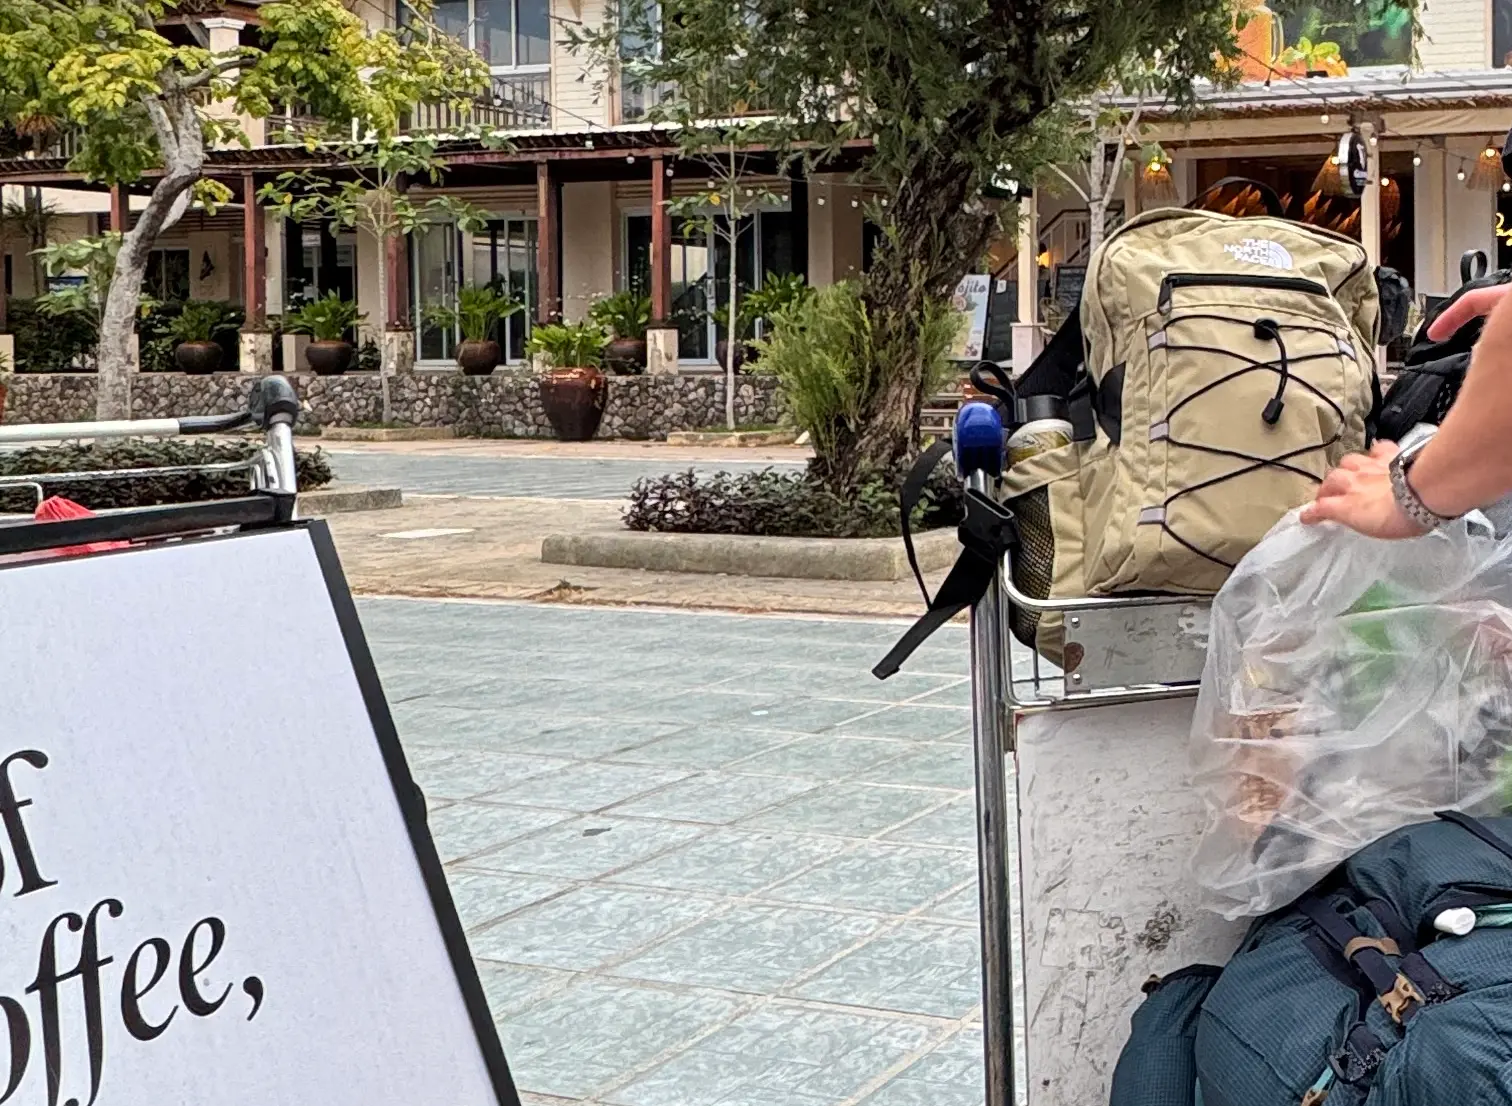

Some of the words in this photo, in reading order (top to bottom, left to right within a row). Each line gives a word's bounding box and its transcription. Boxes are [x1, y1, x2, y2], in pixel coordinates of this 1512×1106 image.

[1223, 243, 1269, 257] NORTH
[1241, 239, 1269, 249] THE
[1234, 251, 1269, 266] FACE
[957, 280, 987, 297] ojito
[0, 750, 58, 897] f
